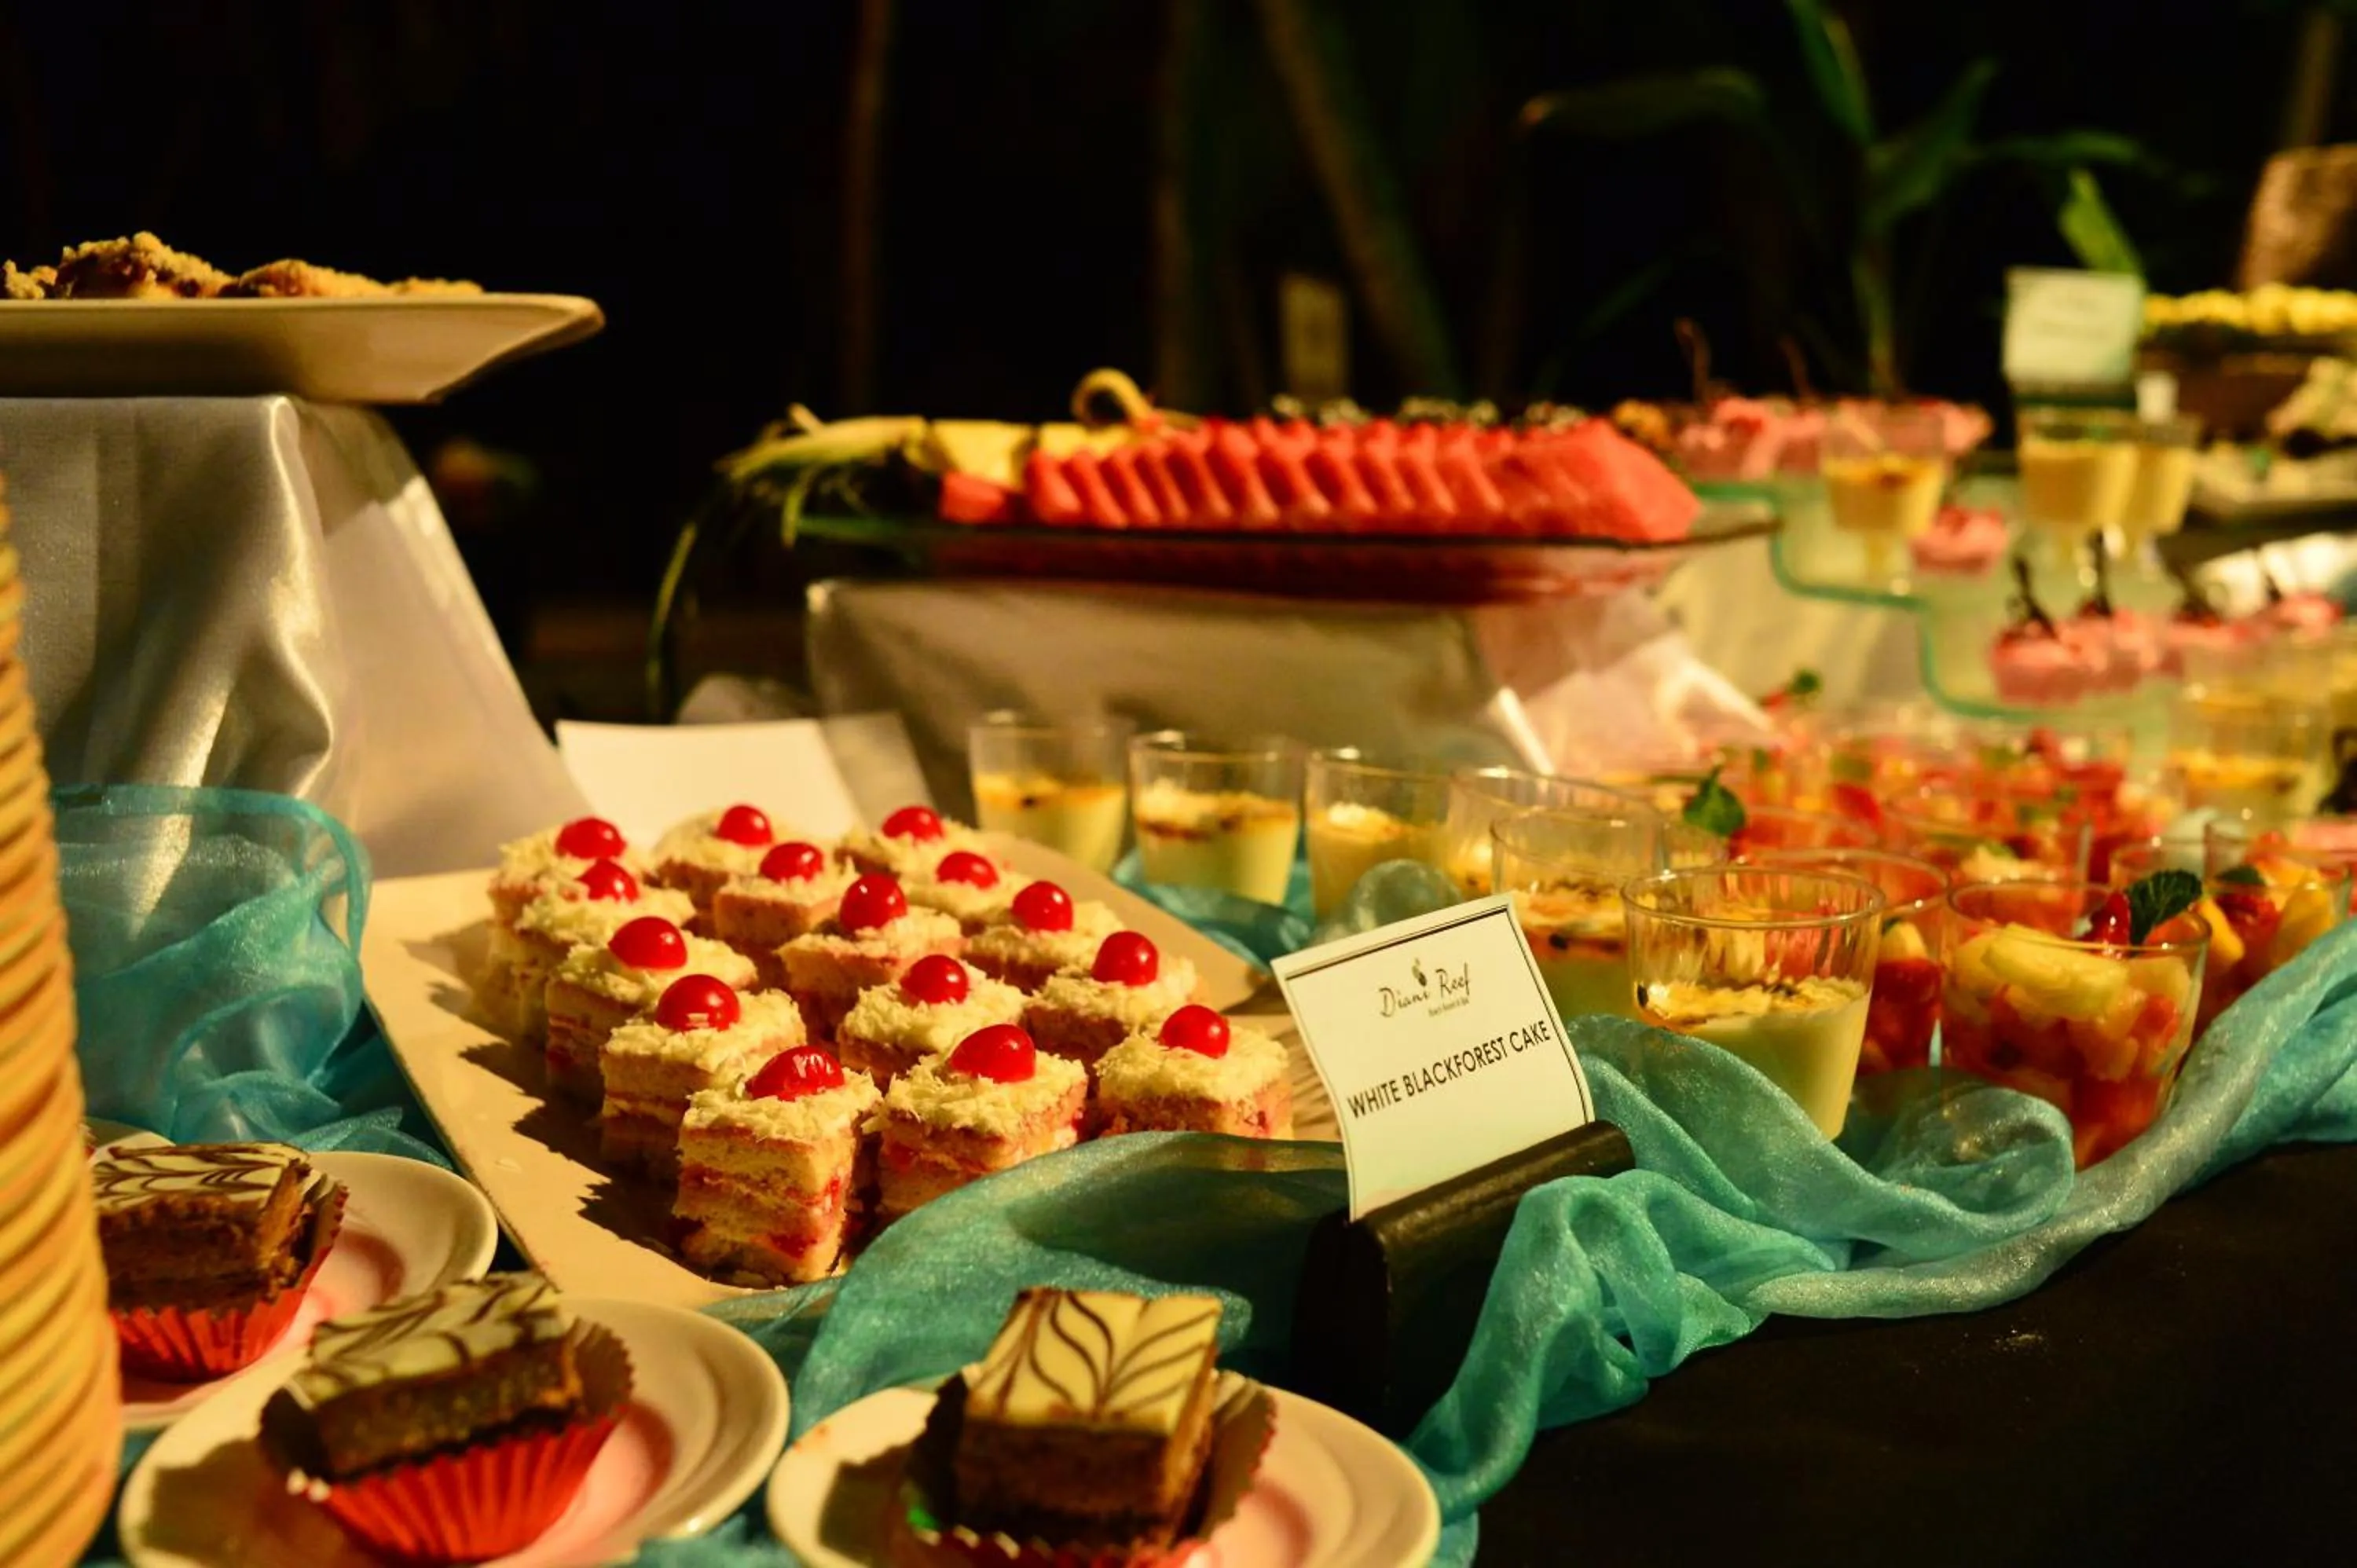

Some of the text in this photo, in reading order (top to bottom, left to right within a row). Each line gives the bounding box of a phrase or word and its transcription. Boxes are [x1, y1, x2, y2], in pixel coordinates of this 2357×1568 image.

[1435, 962, 1469, 997] Reef
[1347, 1020, 1551, 1119] WHITE BLACKFOREST CAKE
